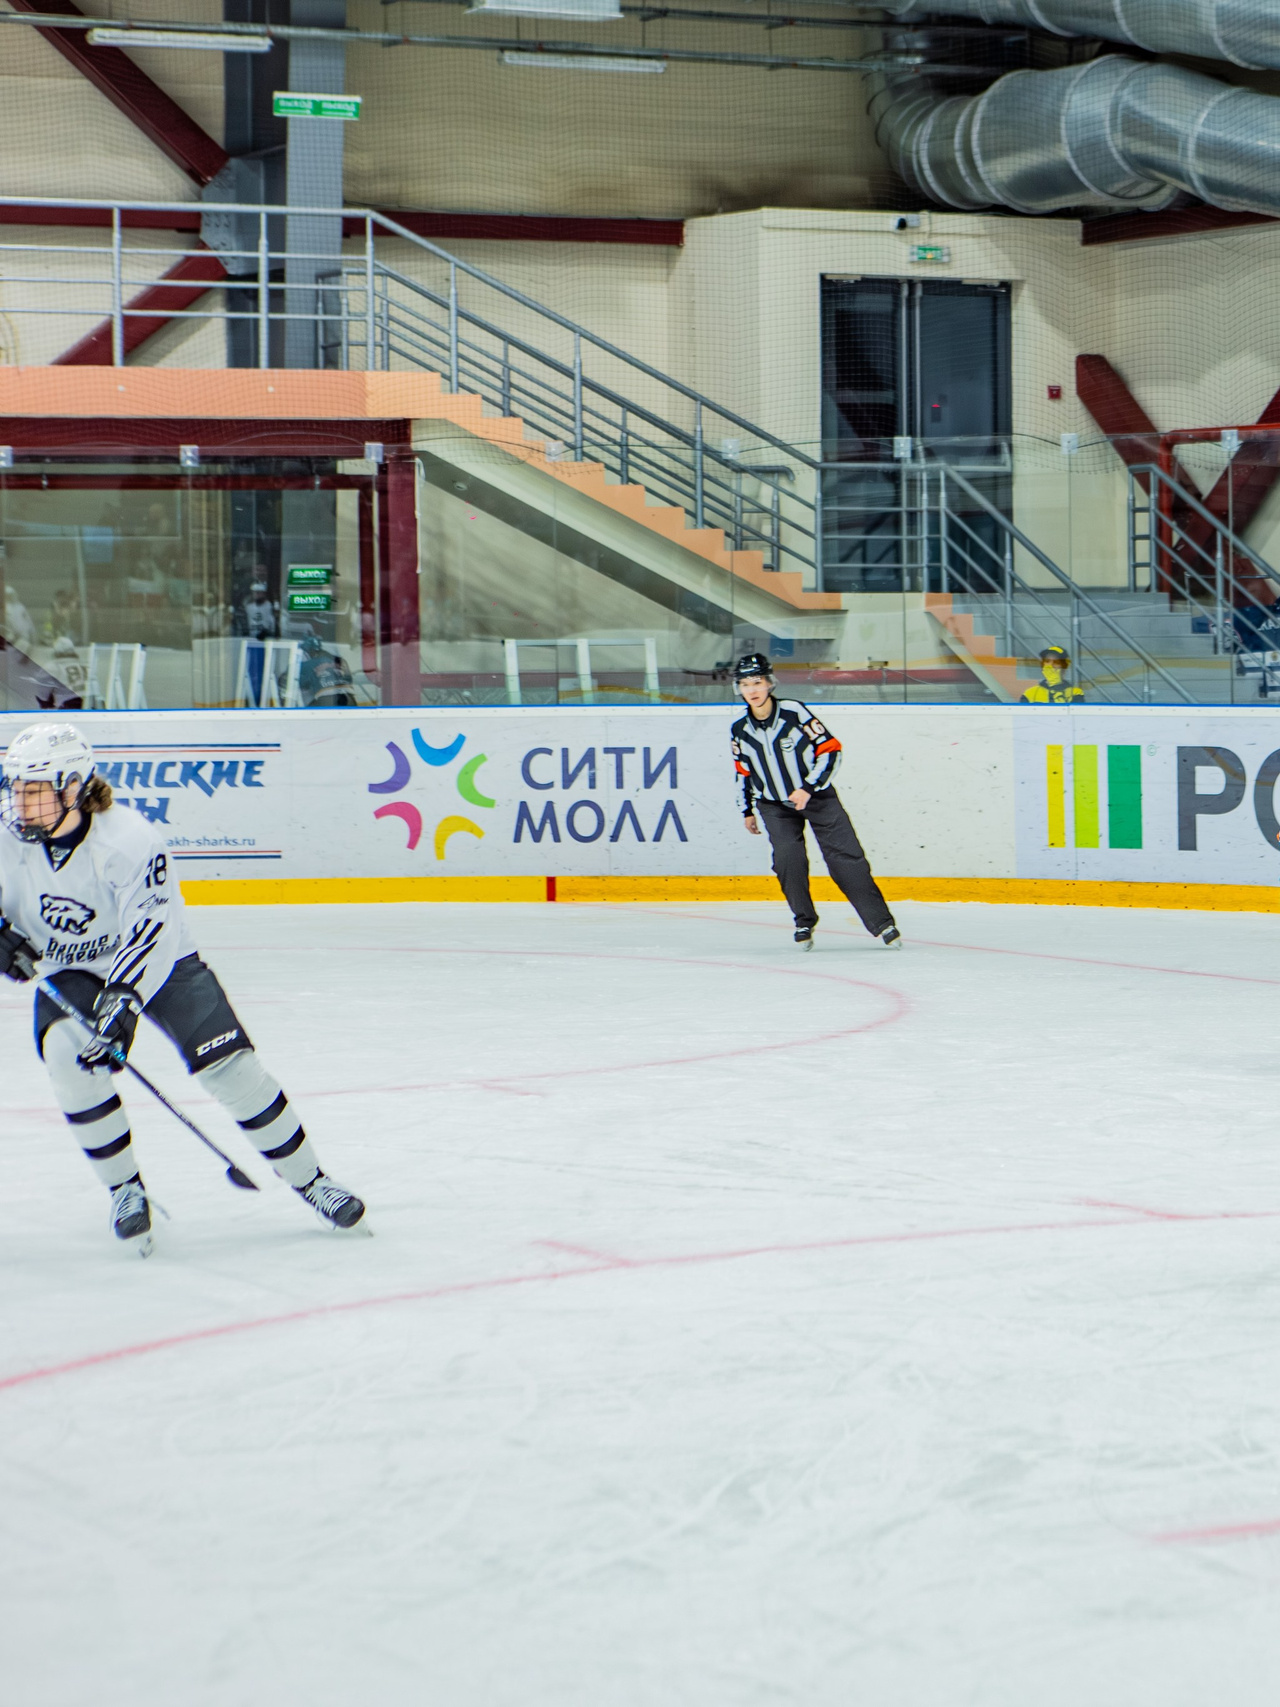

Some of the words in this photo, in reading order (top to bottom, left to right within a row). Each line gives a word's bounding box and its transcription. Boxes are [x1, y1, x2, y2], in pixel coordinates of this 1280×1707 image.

[292, 570, 327, 578] ВЫХОД
[293, 596, 327, 604] ВЫХОД
[803, 718, 826, 741] 16
[95, 761, 266, 798] ИНСКИЕ
[521, 747, 677, 790] СИТИ
[513, 800, 689, 843] МОЛЛ
[167, 836, 256, 848] akh-sharks.ru
[145, 853, 167, 888] 18
[195, 1029, 239, 1057] CCM
